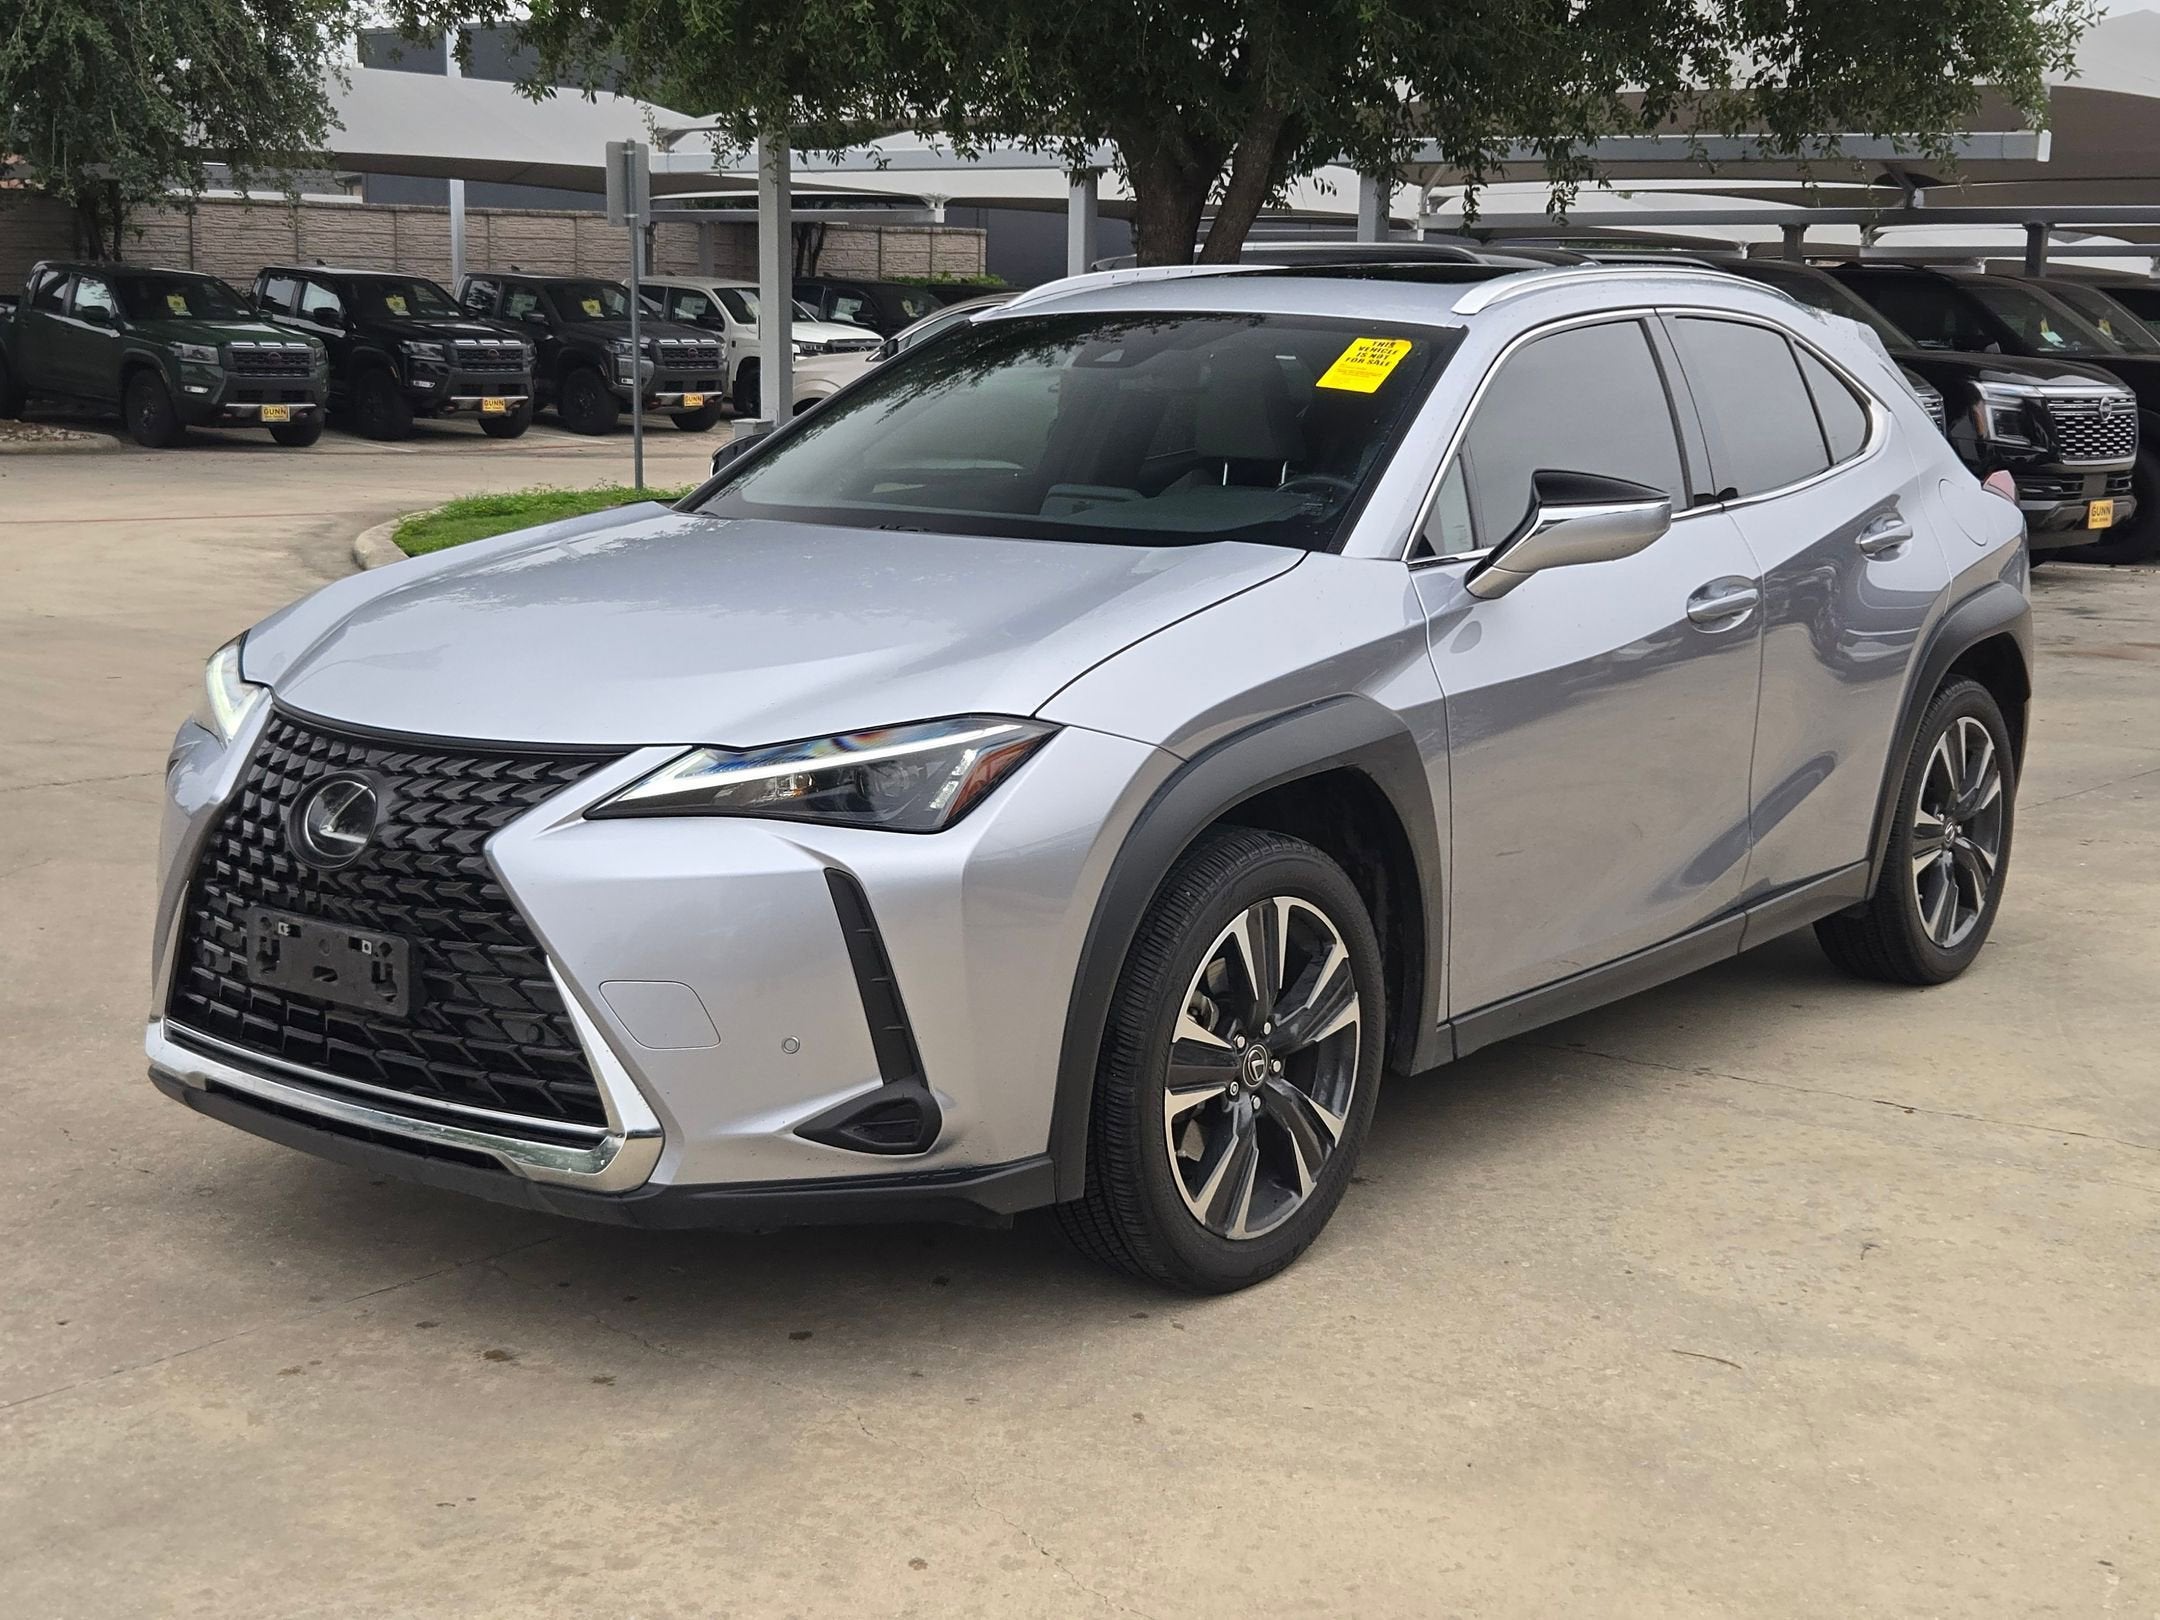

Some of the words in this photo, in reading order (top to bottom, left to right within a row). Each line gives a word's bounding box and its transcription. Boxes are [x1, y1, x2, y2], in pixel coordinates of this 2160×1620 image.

[1358, 346, 1398, 354] VEHICLE
[263, 407, 286, 415] GUNN
[2091, 506, 2111, 516] GUNN
